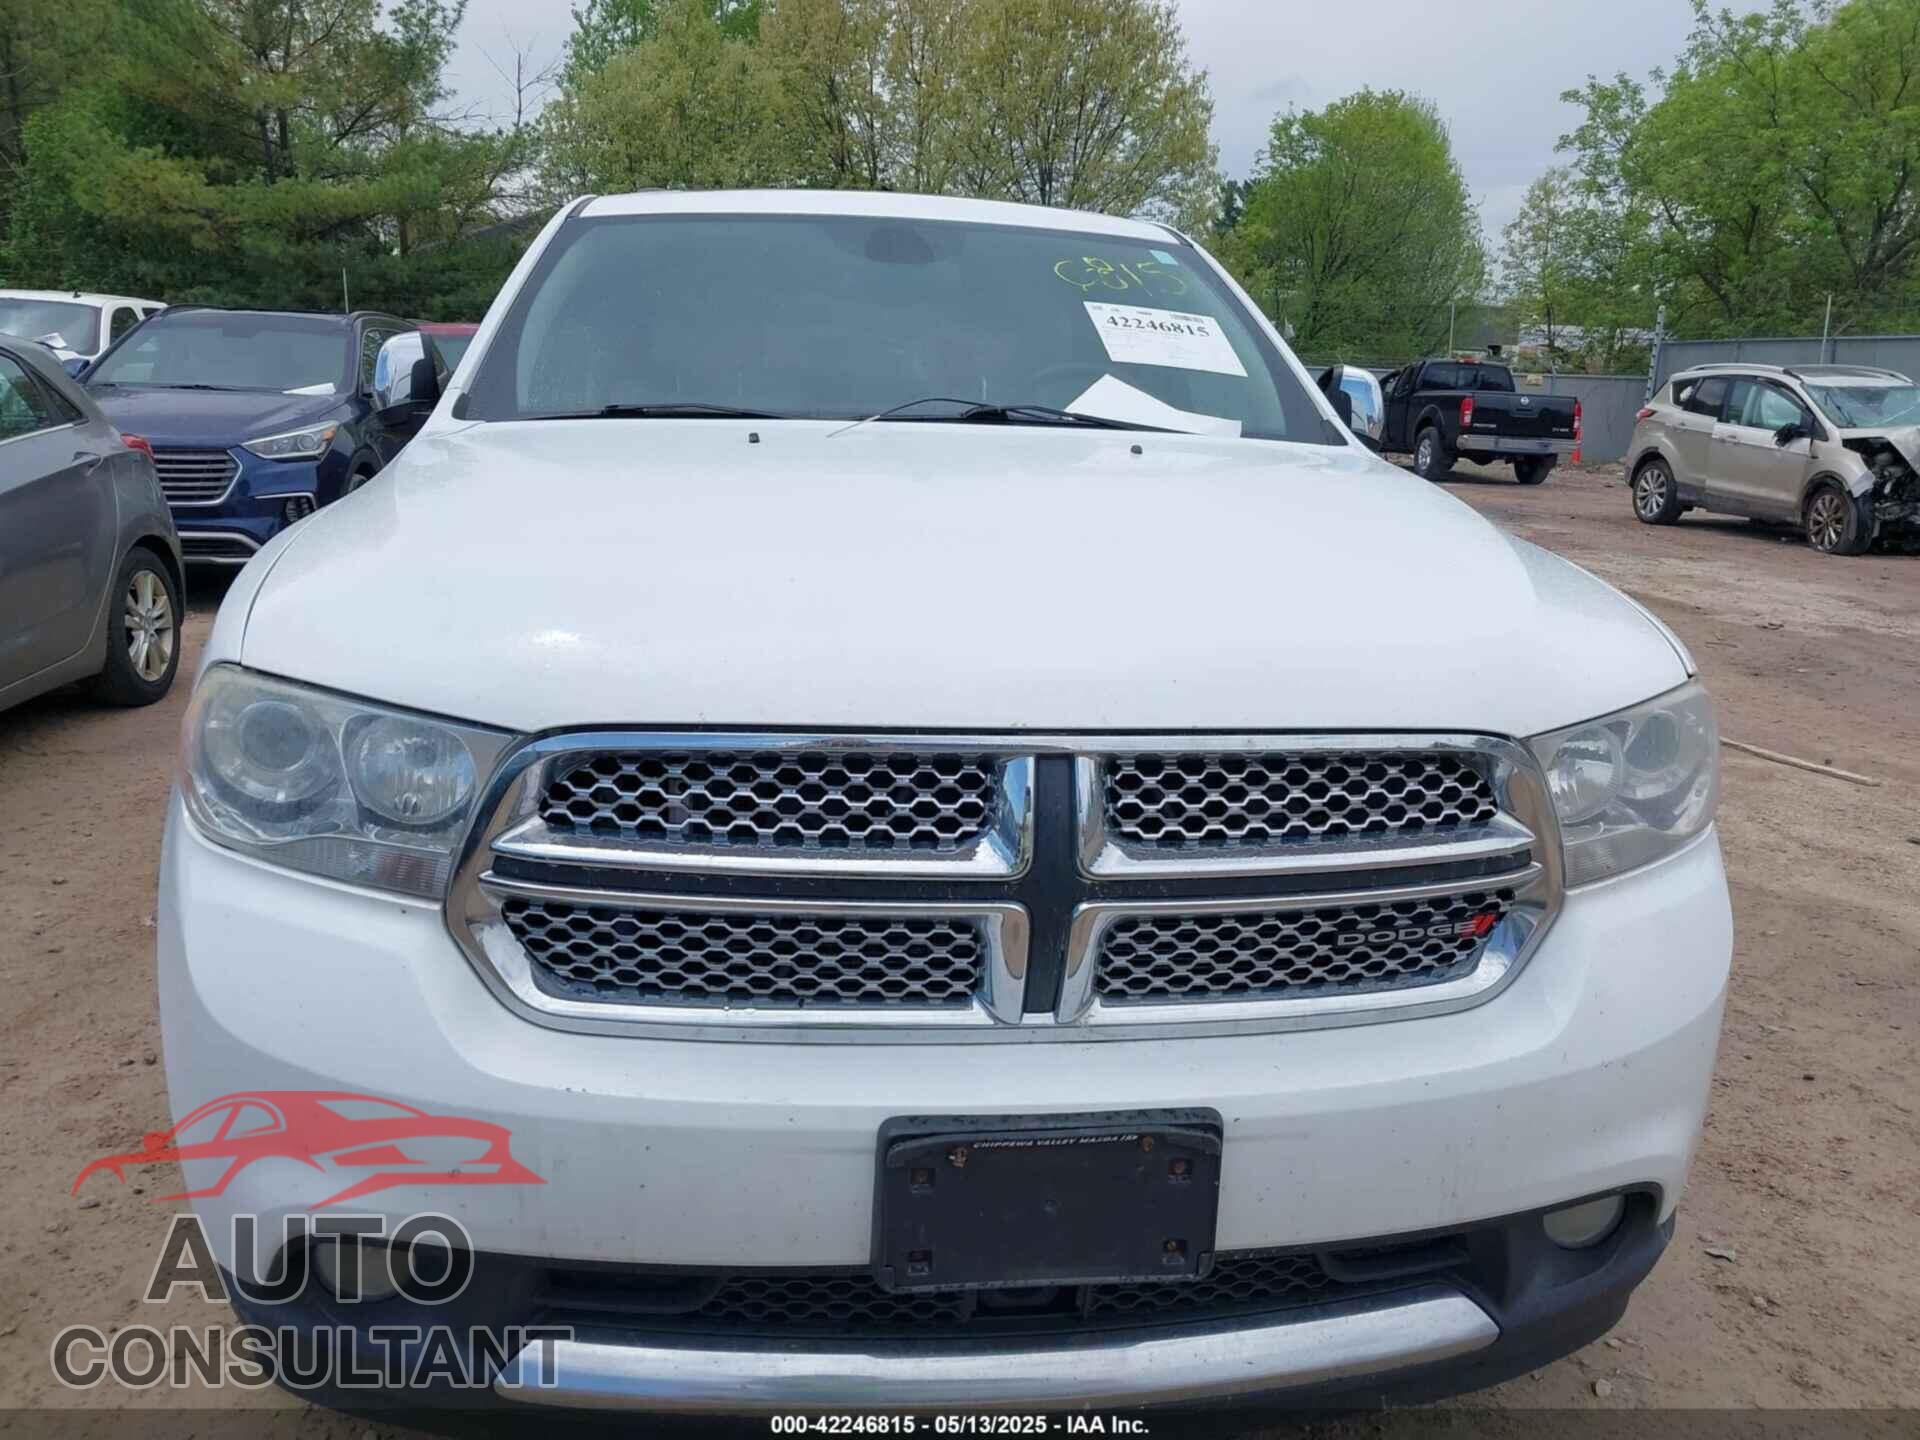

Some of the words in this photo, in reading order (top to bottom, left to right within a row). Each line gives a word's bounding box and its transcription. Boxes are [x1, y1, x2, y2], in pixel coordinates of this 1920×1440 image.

[1106, 315, 1210, 337] 42246815
[1337, 921, 1477, 946] DODGE
[1037, 1137, 1077, 1146] VALLEY
